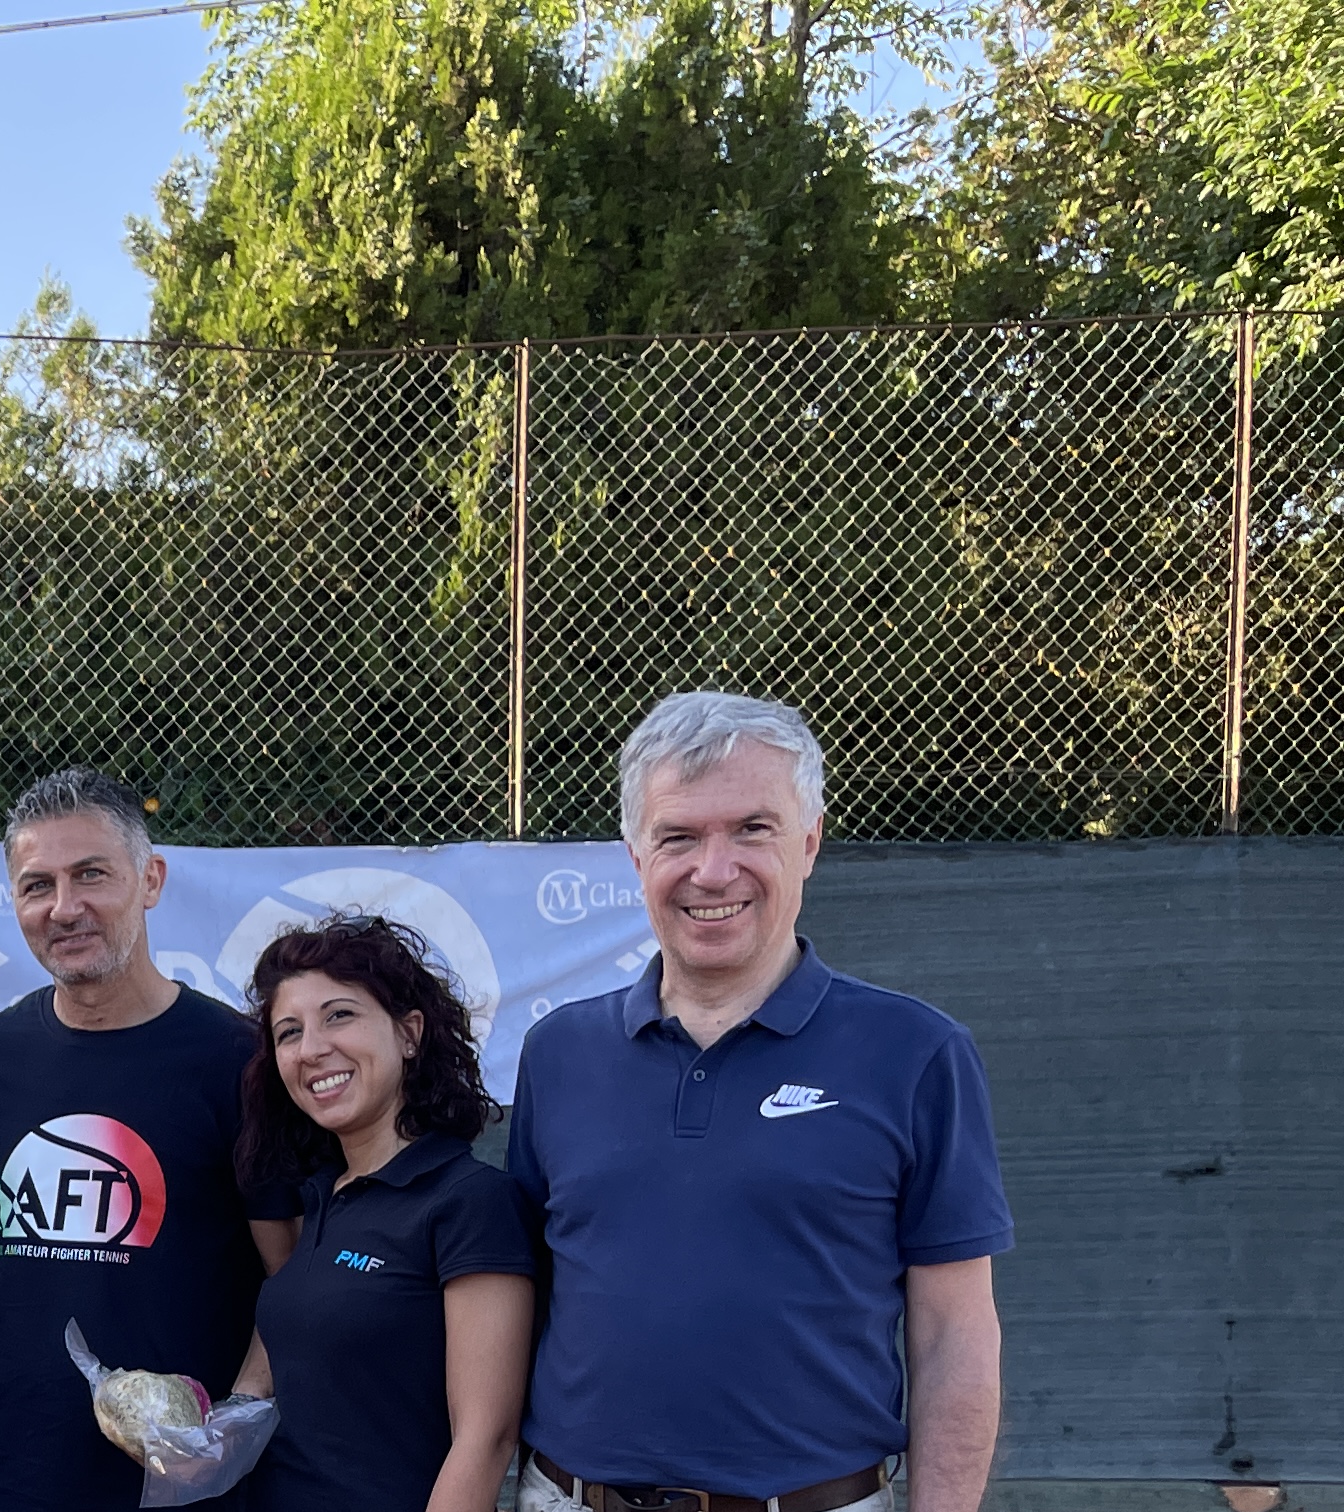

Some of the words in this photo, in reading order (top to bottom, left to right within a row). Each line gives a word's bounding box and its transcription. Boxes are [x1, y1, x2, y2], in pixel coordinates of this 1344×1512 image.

[771, 1084, 824, 1107] NIKE
[4, 1244, 49, 1259] AMATEUR
[50, 1247, 92, 1261] FIGHTER
[93, 1249, 130, 1264] TENNIS
[334, 1250, 385, 1272] PMF
